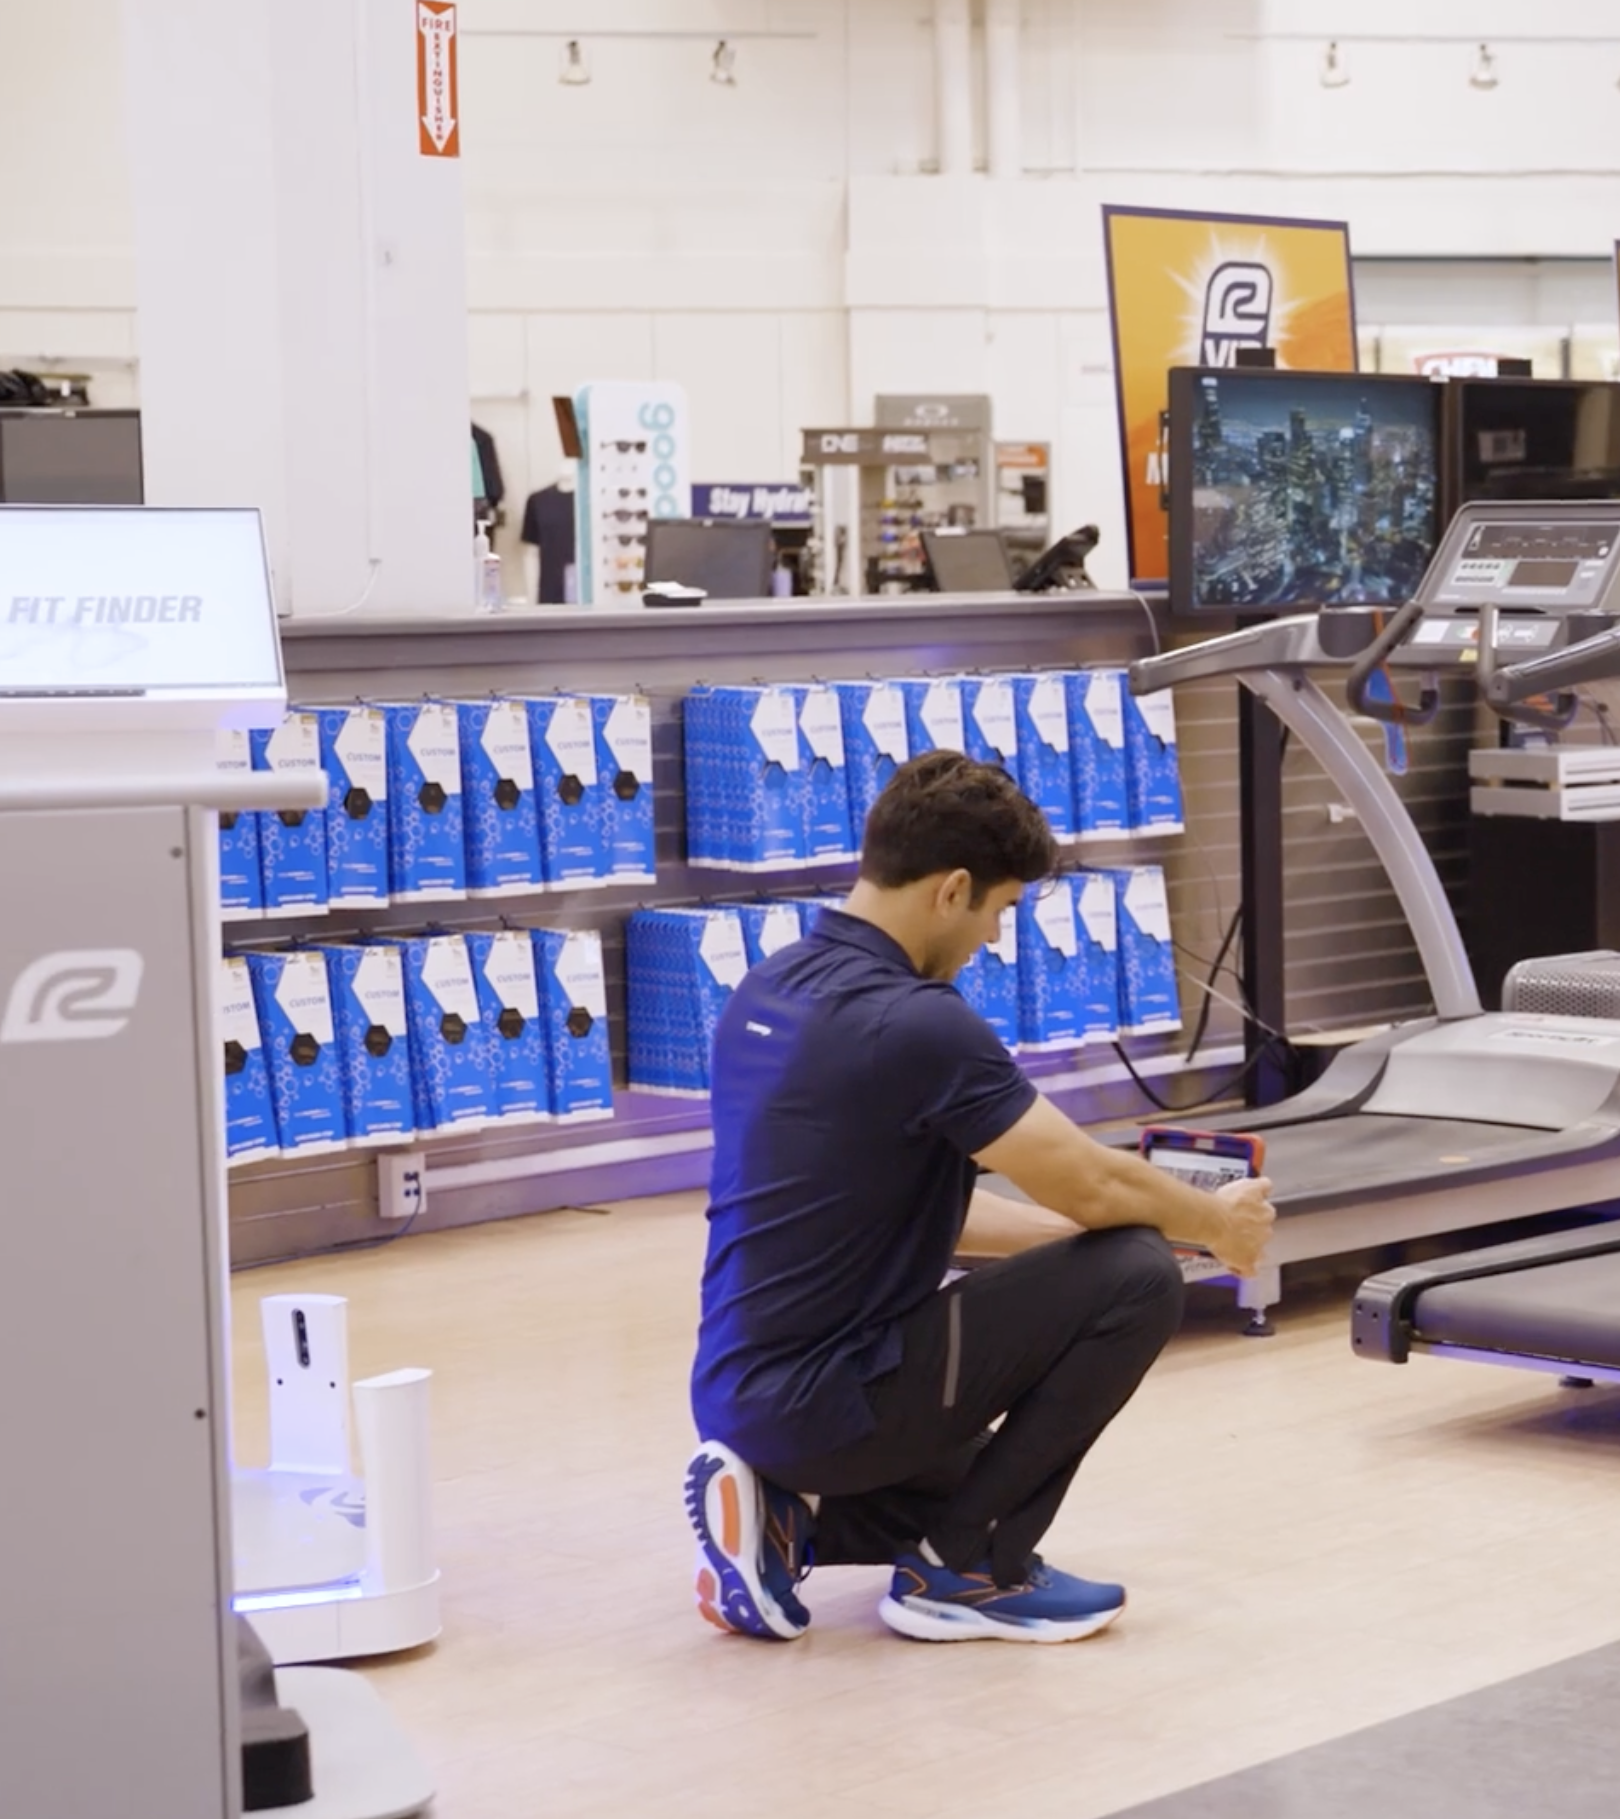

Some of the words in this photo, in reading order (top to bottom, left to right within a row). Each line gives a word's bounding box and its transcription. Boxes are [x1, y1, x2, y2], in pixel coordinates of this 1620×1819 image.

[421, 17, 452, 31] FIRE
[432, 32, 444, 140] EXTINGUISHER
[1203, 338, 1264, 368] VI
[708, 487, 751, 519] Stay
[8, 596, 66, 624] FIT
[72, 595, 203, 624] FINDER
[557, 740, 591, 751] CUSTOM
[615, 737, 648, 747] CUSTOM
[420, 748, 456, 758] CUSTOM
[493, 744, 527, 755] CUSTOM
[346, 751, 382, 763] CUSTOM
[216, 760, 248, 770] USTOM
[278, 758, 317, 770] CUSTOM
[435, 976, 470, 989] CUSTOM
[496, 972, 531, 984] CUSTOM
[566, 972, 600, 983] CUSTOM
[364, 989, 400, 1000] CUSTOM
[222, 1001, 251, 1014] STOM
[289, 996, 326, 1009] CUSTOM
